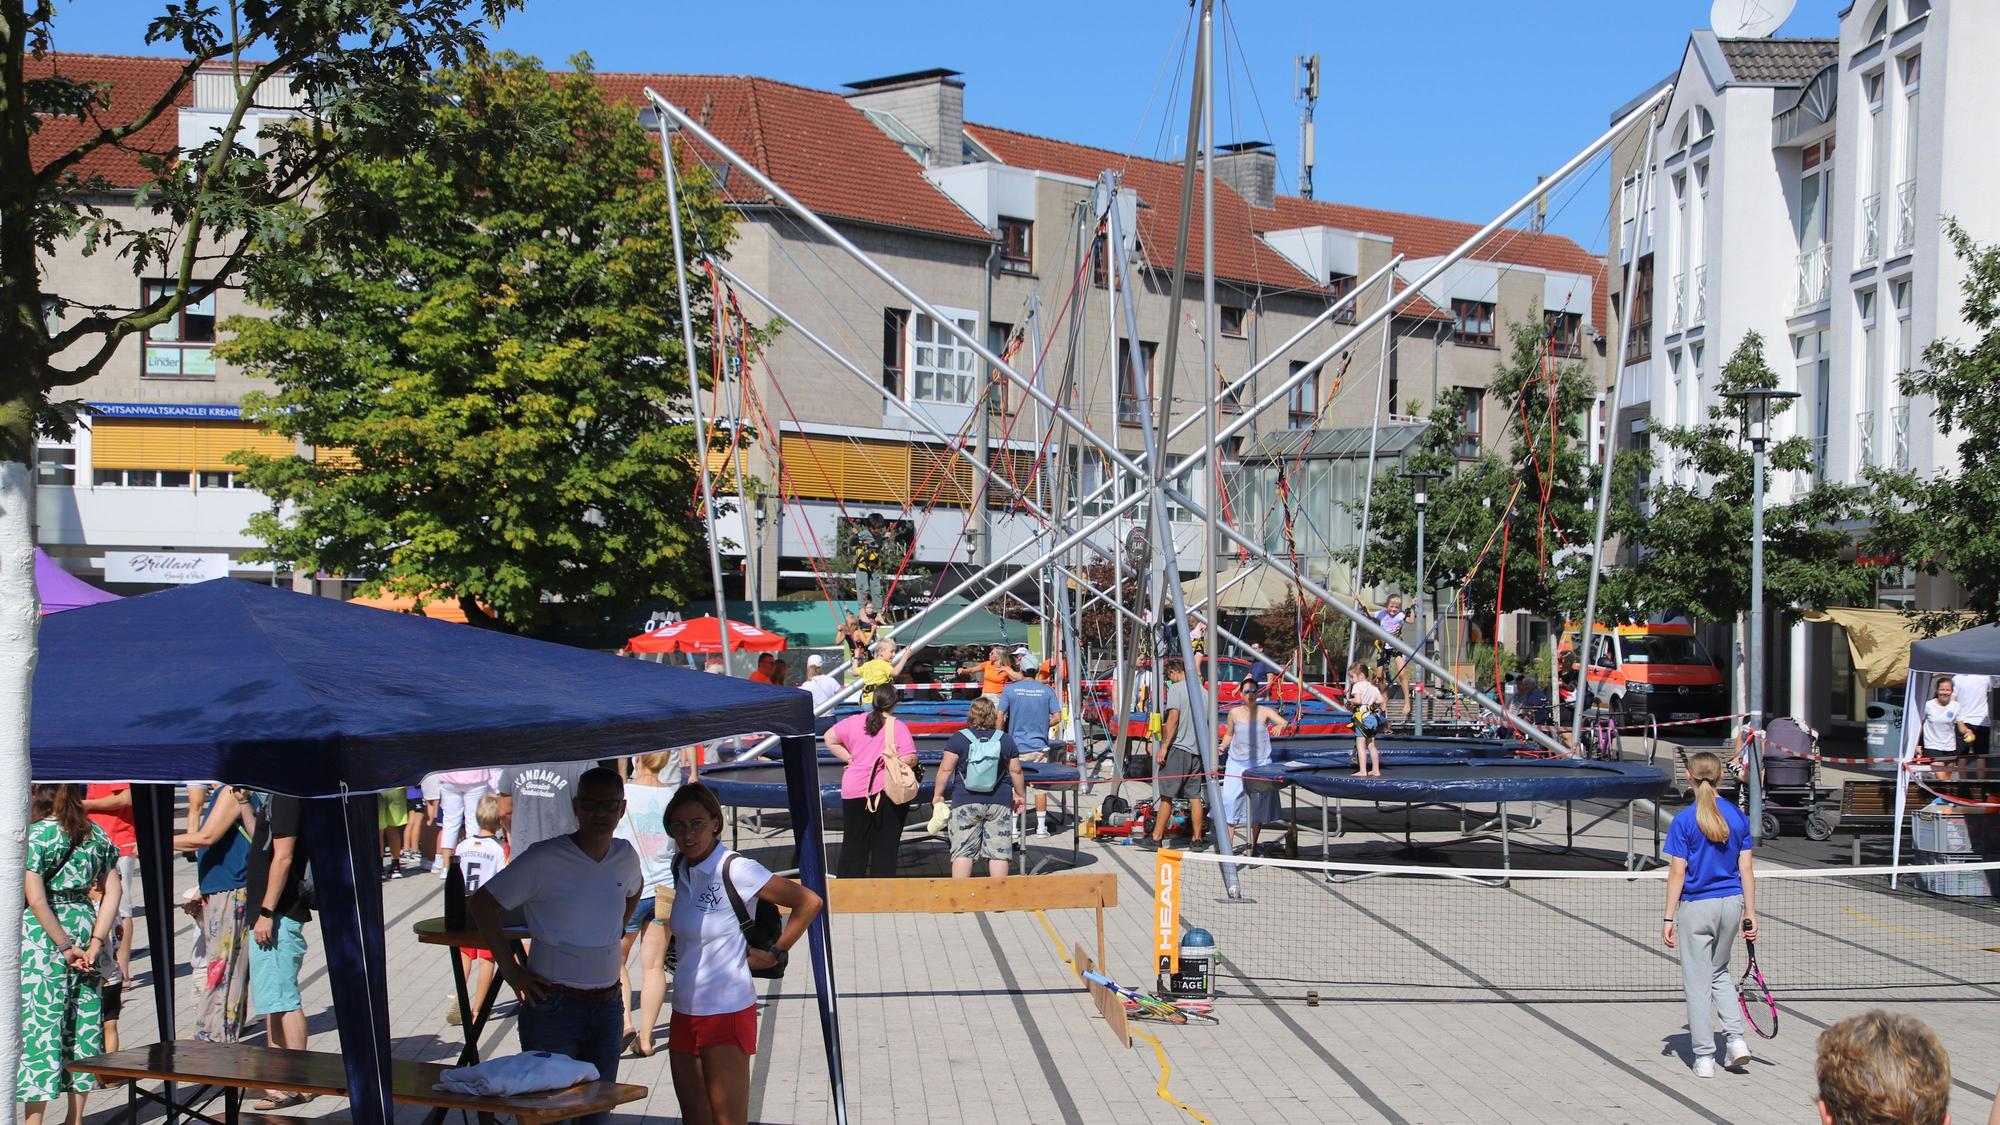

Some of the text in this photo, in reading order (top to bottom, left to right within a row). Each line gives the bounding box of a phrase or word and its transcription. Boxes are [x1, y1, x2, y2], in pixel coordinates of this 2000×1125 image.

[91, 405, 207, 416] CHTSANWALTSKANZLEI
[129, 554, 206, 573] Brillant
[514, 769, 568, 790] KANDAHAR
[1160, 863, 1172, 950] HEAD
